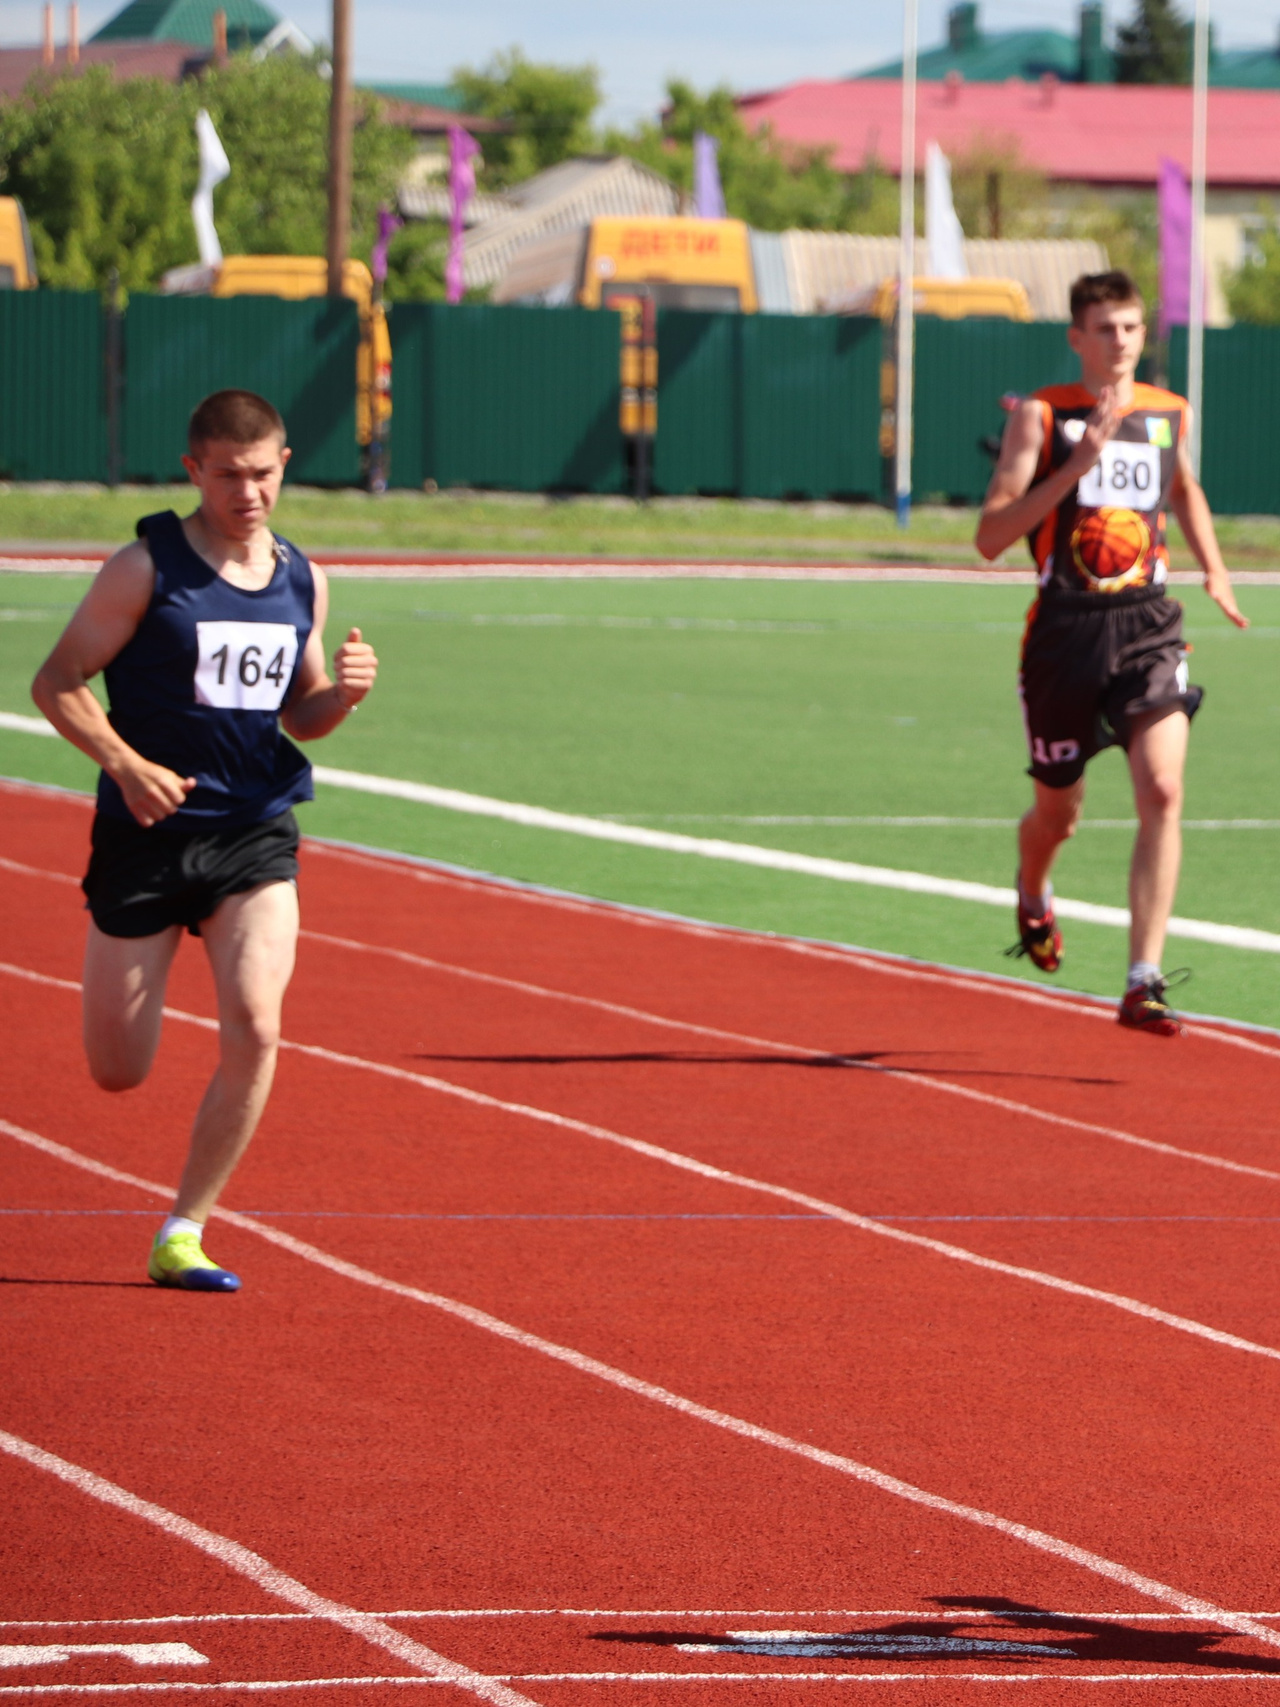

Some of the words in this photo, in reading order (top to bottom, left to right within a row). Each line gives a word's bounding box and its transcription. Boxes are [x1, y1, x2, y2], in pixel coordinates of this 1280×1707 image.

[620, 229, 720, 259] ДЕТИ
[1096, 459, 1151, 491] 180
[211, 643, 285, 688] 164
